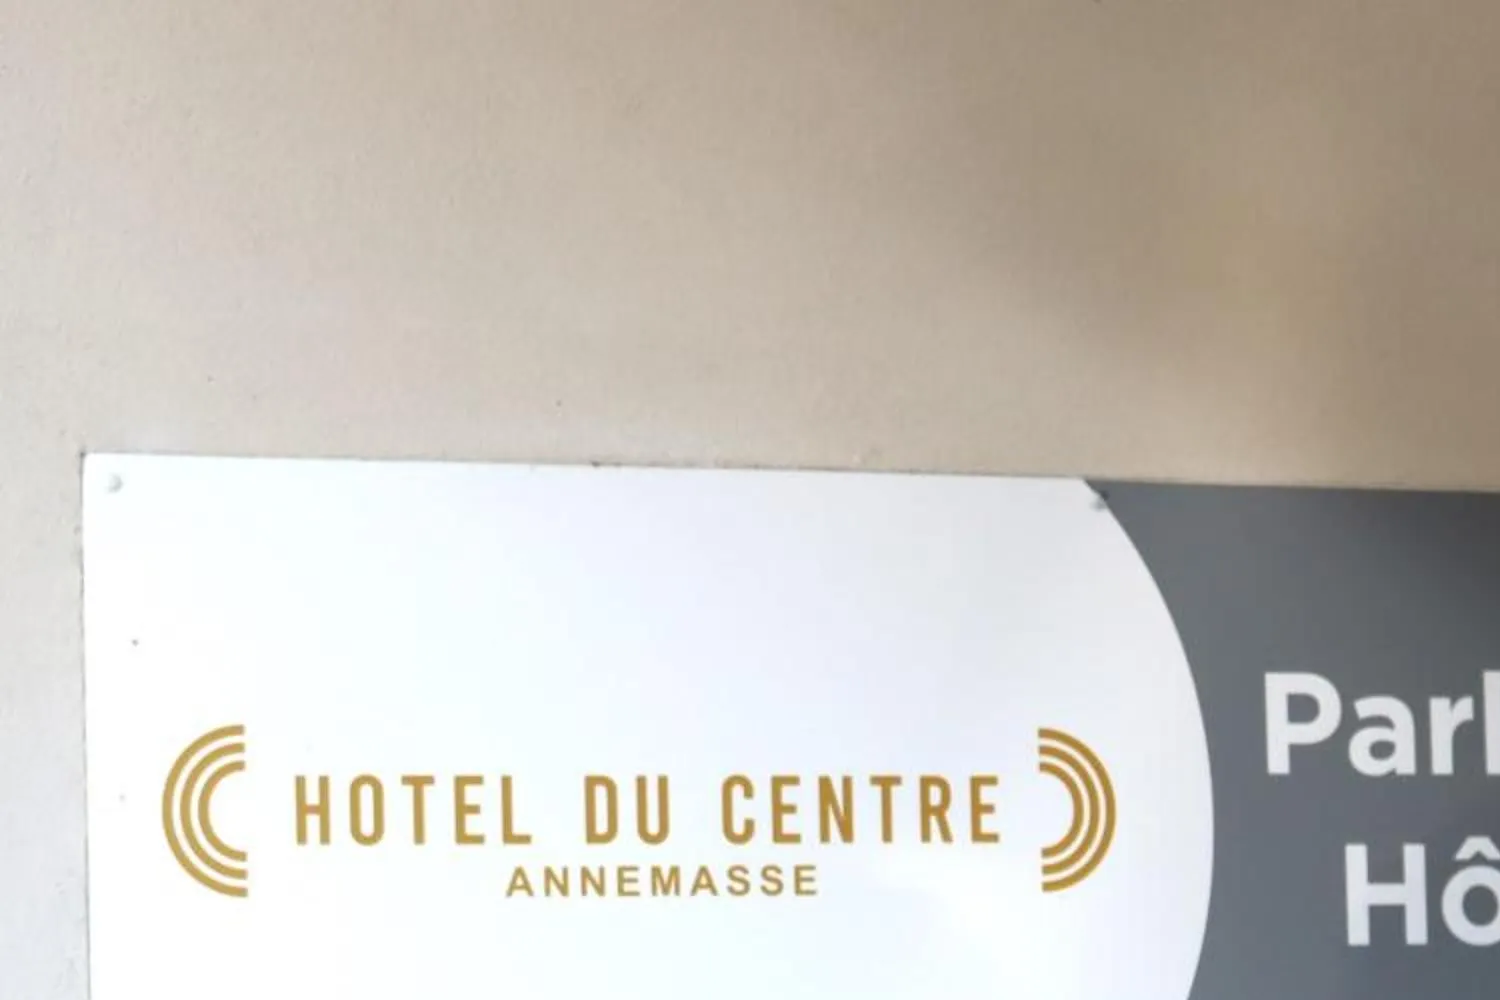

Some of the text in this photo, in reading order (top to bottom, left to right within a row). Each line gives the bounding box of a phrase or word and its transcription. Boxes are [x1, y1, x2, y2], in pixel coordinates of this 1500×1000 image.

[294, 774, 1001, 847] HOTEL DU CENTRE
[504, 864, 818, 898] ANNEMASSE
